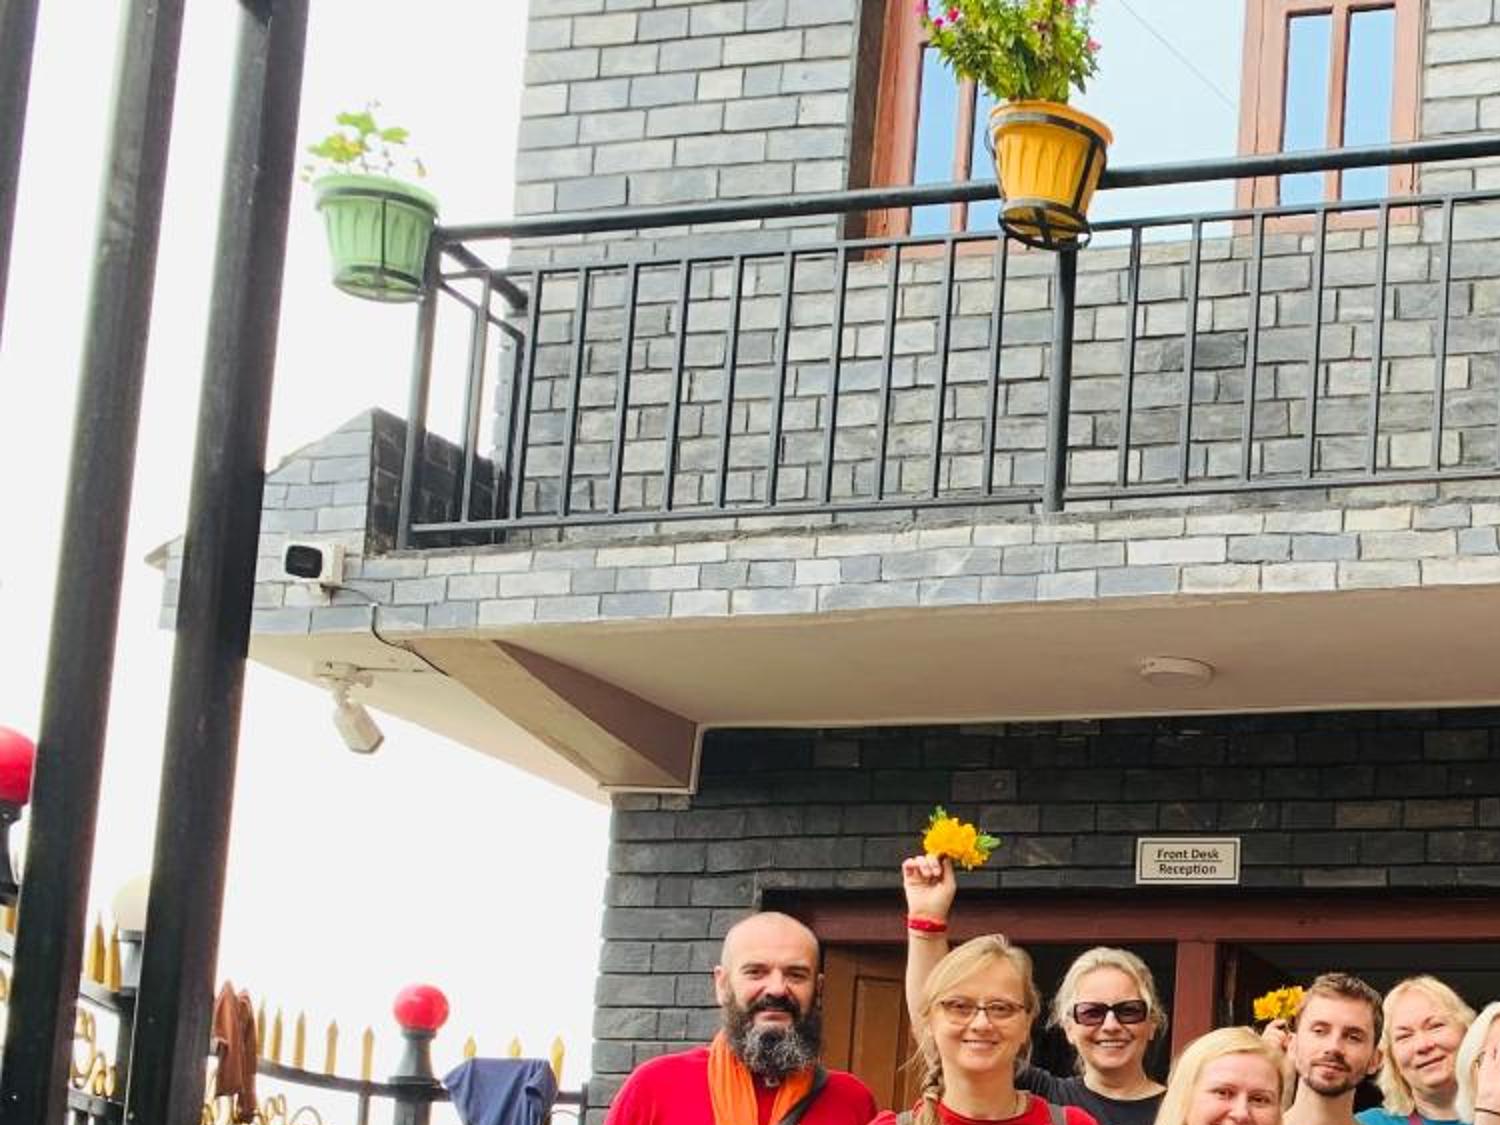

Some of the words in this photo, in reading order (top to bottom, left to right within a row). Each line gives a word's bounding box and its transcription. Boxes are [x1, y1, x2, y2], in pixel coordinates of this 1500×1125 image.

[1156, 848, 1188, 860] Front
[1190, 848, 1220, 860] Desk
[1158, 863, 1217, 877] Reception
